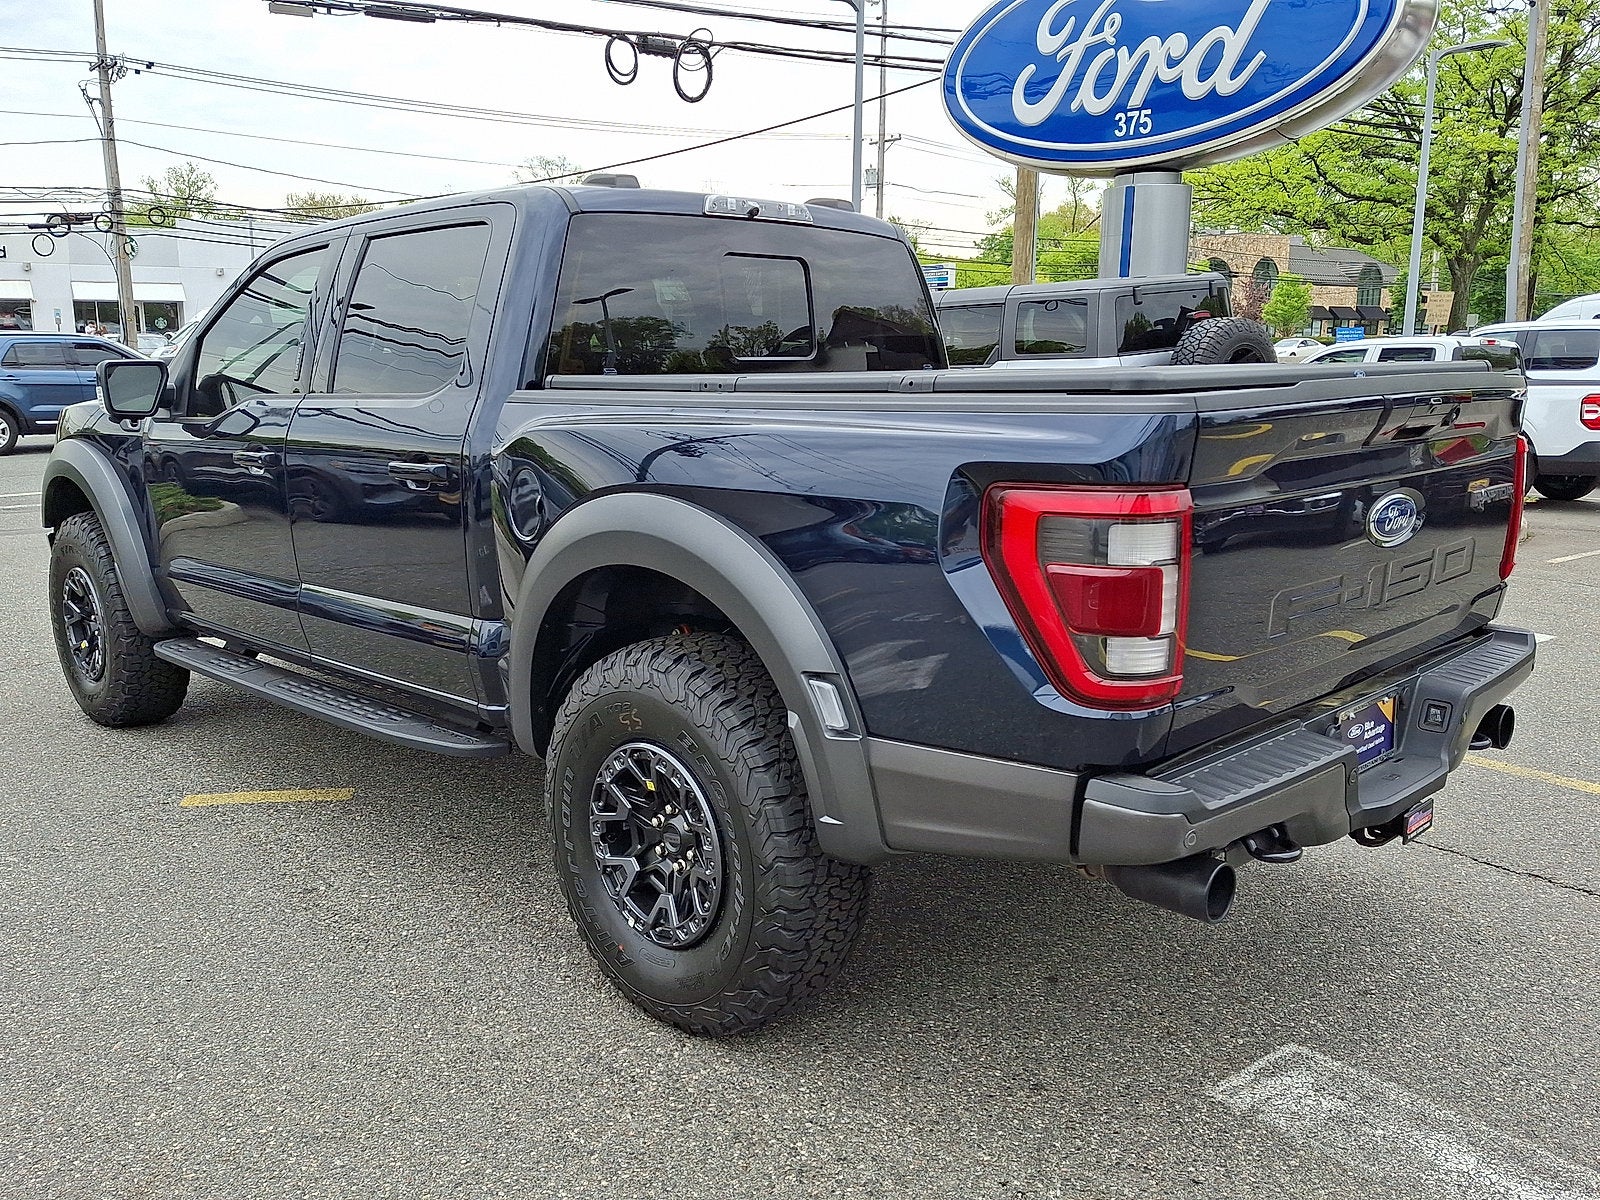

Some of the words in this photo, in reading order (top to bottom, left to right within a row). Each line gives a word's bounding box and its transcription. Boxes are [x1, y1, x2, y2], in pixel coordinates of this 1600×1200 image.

[1012, 0, 1267, 126] Ford
[1113, 109, 1153, 138] 375
[1384, 505, 1411, 532] Ford
[1267, 537, 1476, 640] F-150
